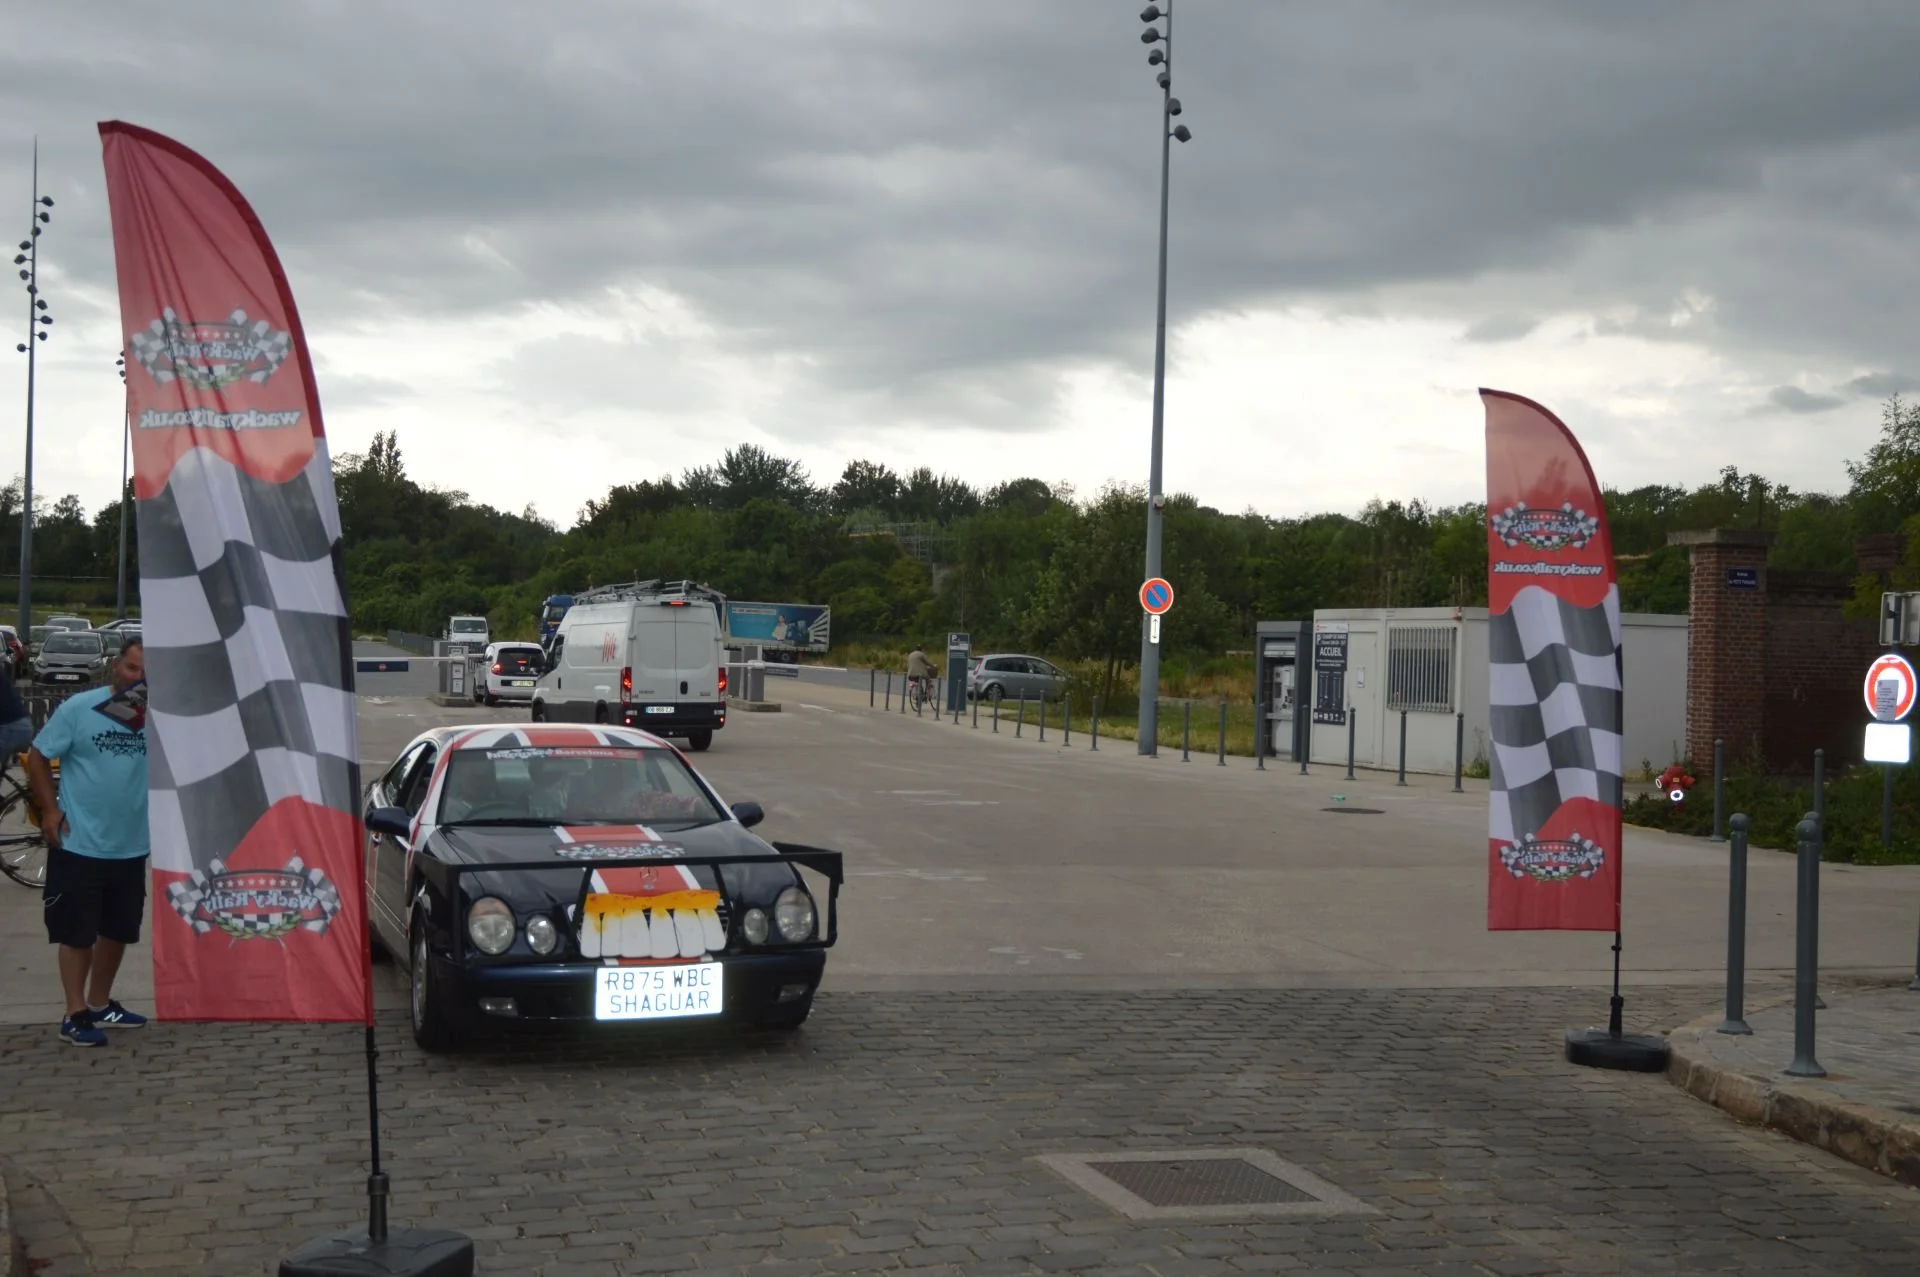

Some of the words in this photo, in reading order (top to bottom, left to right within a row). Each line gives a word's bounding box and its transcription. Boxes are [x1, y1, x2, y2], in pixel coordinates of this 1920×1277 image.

[1320, 647, 1343, 657] ACCUEIL
[607, 971, 665, 990] R875
[673, 968, 712, 988] WBC
[610, 991, 710, 1013] SHAGUAR
